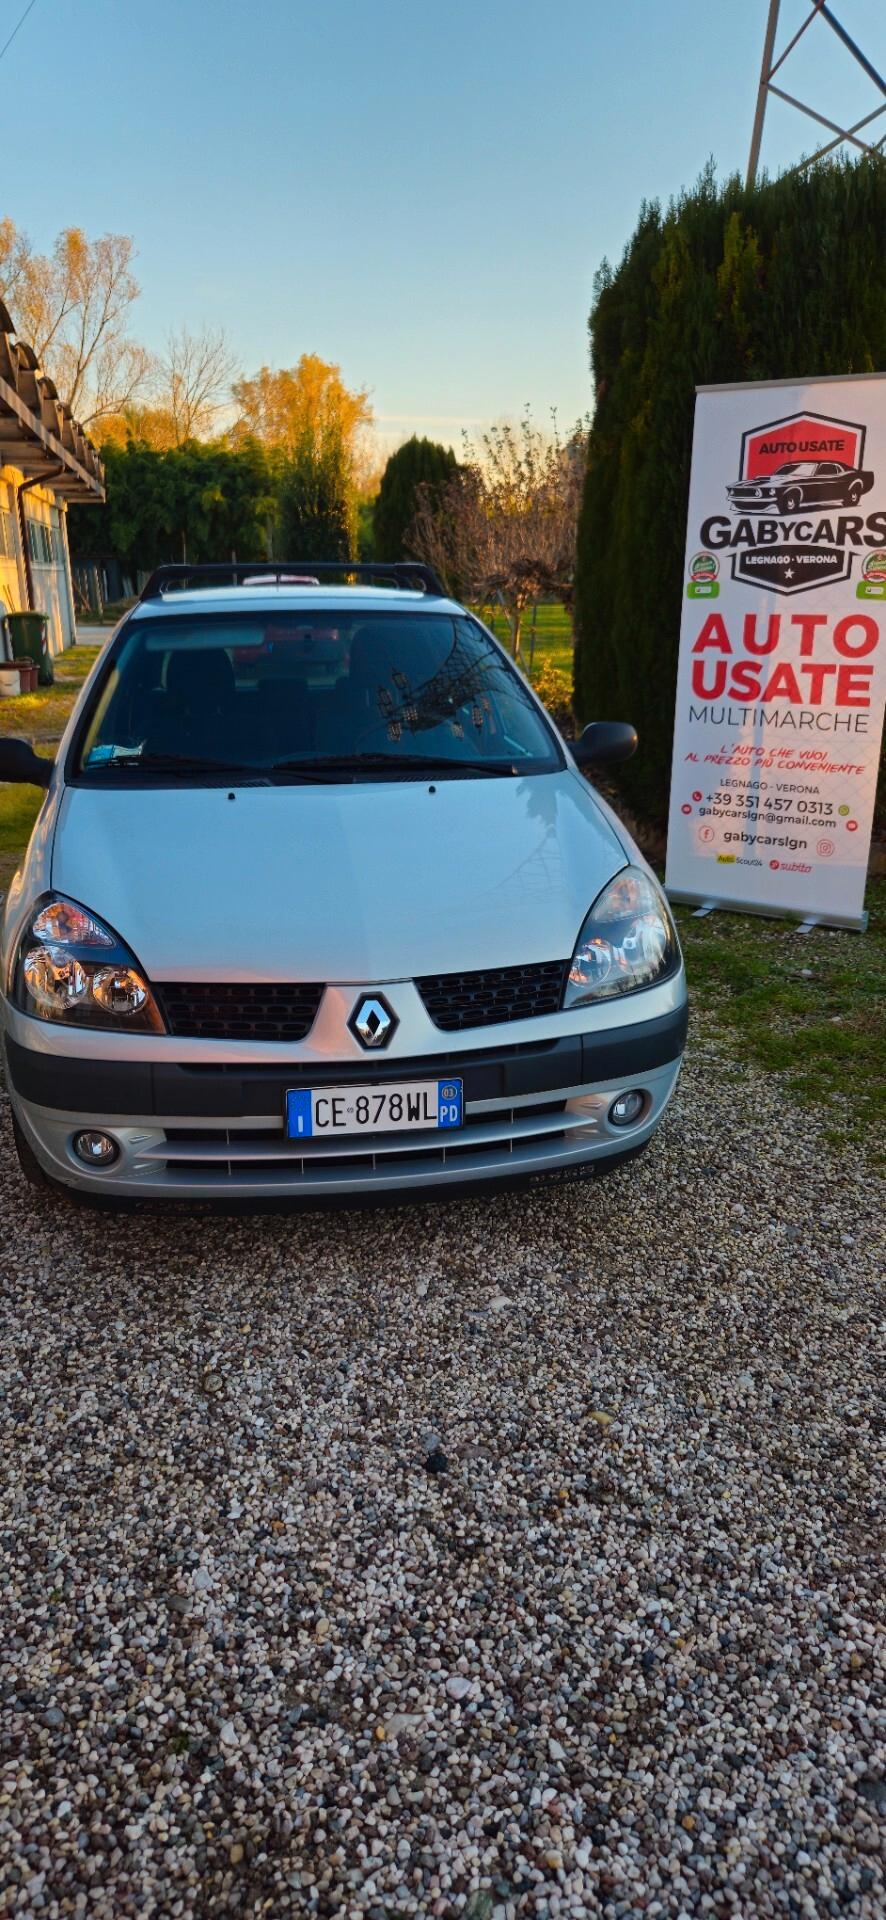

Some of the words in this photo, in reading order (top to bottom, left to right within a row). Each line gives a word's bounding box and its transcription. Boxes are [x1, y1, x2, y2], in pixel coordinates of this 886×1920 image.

[759, 442, 797, 454] AUTO
[799, 440, 845, 452] USATE
[700, 511, 886, 550] GABYCARS
[745, 555, 790, 564] LEGNAGO
[796, 555, 838, 564] VERONA
[692, 613, 879, 658] AUTO
[692, 660, 874, 707] USATE
[688, 704, 869, 733] MULTIMARCHE
[684, 752, 700, 762] AL
[704, 754, 750, 767] PREZZO
[777, 760, 866, 775] CONVENIENTE
[720, 744, 765, 757] L'AUTO
[770, 748, 793, 759] CHE
[800, 750, 828, 762] VUOI
[720, 778, 767, 791] LEGNAGO
[776, 783, 820, 795] VERONA
[706, 792, 731, 805] +39
[735, 794, 760, 808] 351
[764, 798, 792, 812] 457
[797, 800, 833, 816] 0313
[440, 1104, 458, 1123] PD
